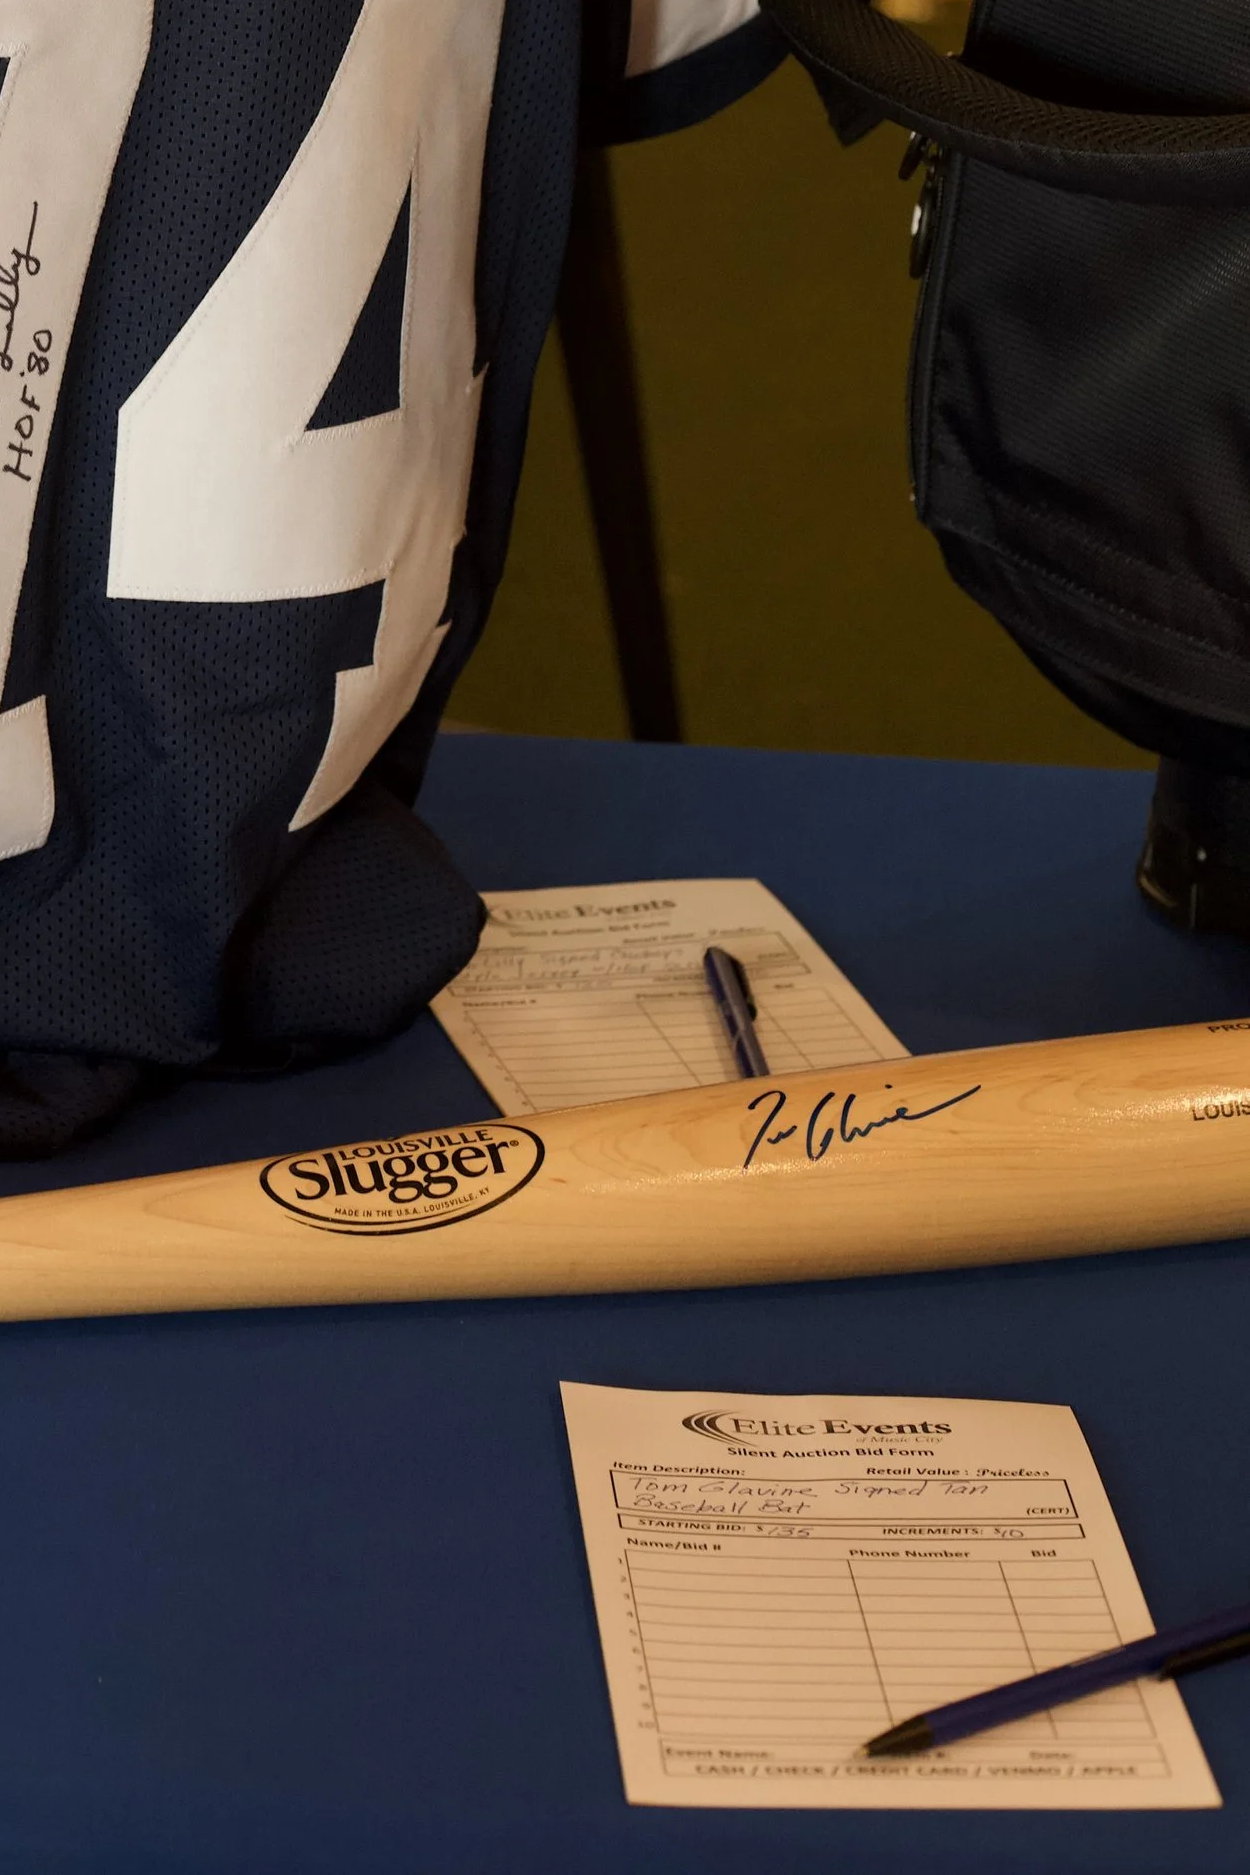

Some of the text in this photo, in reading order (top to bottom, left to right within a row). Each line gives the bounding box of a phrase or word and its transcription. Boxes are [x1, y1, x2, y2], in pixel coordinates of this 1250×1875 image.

[3, 384, 40, 482] HOF
[339, 1129, 493, 1161] LOUISVILLE
[334, 1207, 359, 1217] MADE
[362, 1209, 372, 1217] IN
[376, 1208, 394, 1217] THE
[479, 1187, 490, 1196] KY
[729, 1417, 952, 1436] Elite Events
[868, 1435, 910, 1444] Music
[915, 1436, 944, 1445] City
[727, 1446, 934, 1458] Silent Auction Bid Form
[613, 1461, 746, 1476] Item Description:
[866, 1468, 911, 1476] Retail
[916, 1468, 960, 1476] Value
[976, 1468, 1050, 1477] Priceless
[630, 1477, 989, 1498] Tom Glavine Signed Tan
[633, 1494, 811, 1514] Baseball Bat
[1026, 1506, 1070, 1515] (CERT)
[638, 1519, 712, 1531] STARTING
[716, 1523, 746, 1532] BID:
[882, 1527, 984, 1536] INCREMENTS:
[627, 1537, 707, 1552] Name/Bid
[849, 1549, 970, 1558] Phone Number
[1031, 1549, 1057, 1558] Bid
